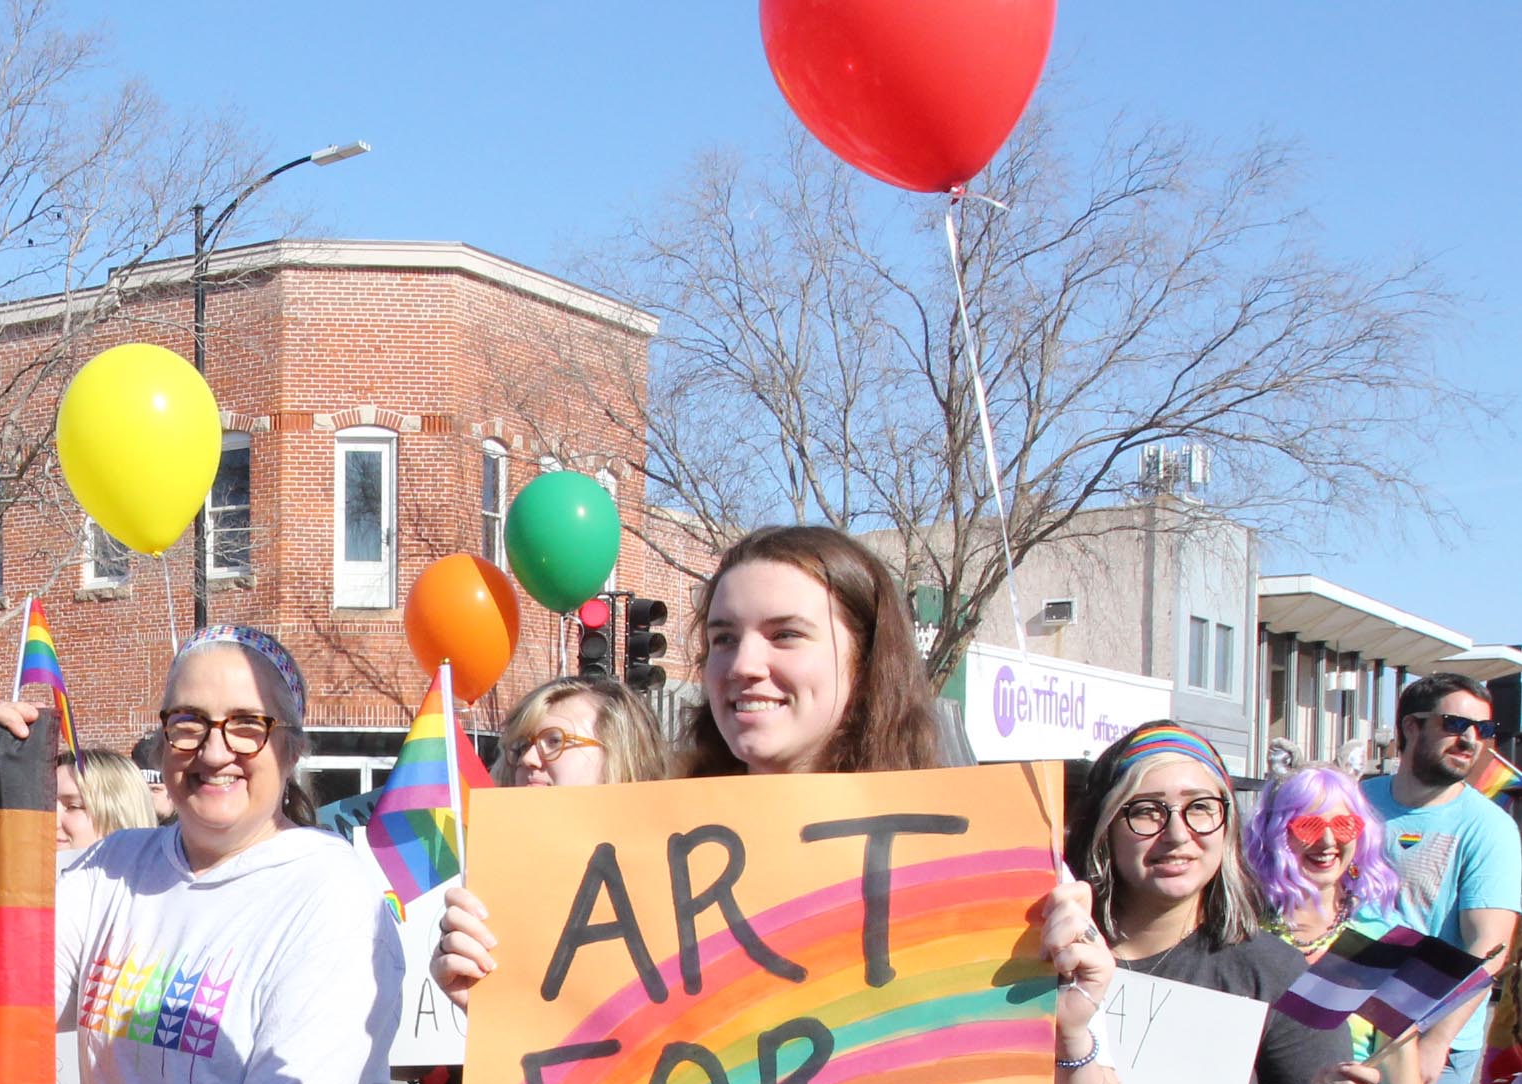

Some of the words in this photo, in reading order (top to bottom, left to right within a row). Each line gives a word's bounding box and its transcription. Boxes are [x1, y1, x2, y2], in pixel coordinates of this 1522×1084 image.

[997, 674, 1085, 731] merrifield
[1093, 714, 1119, 742] office
[540, 813, 970, 1004] ART
